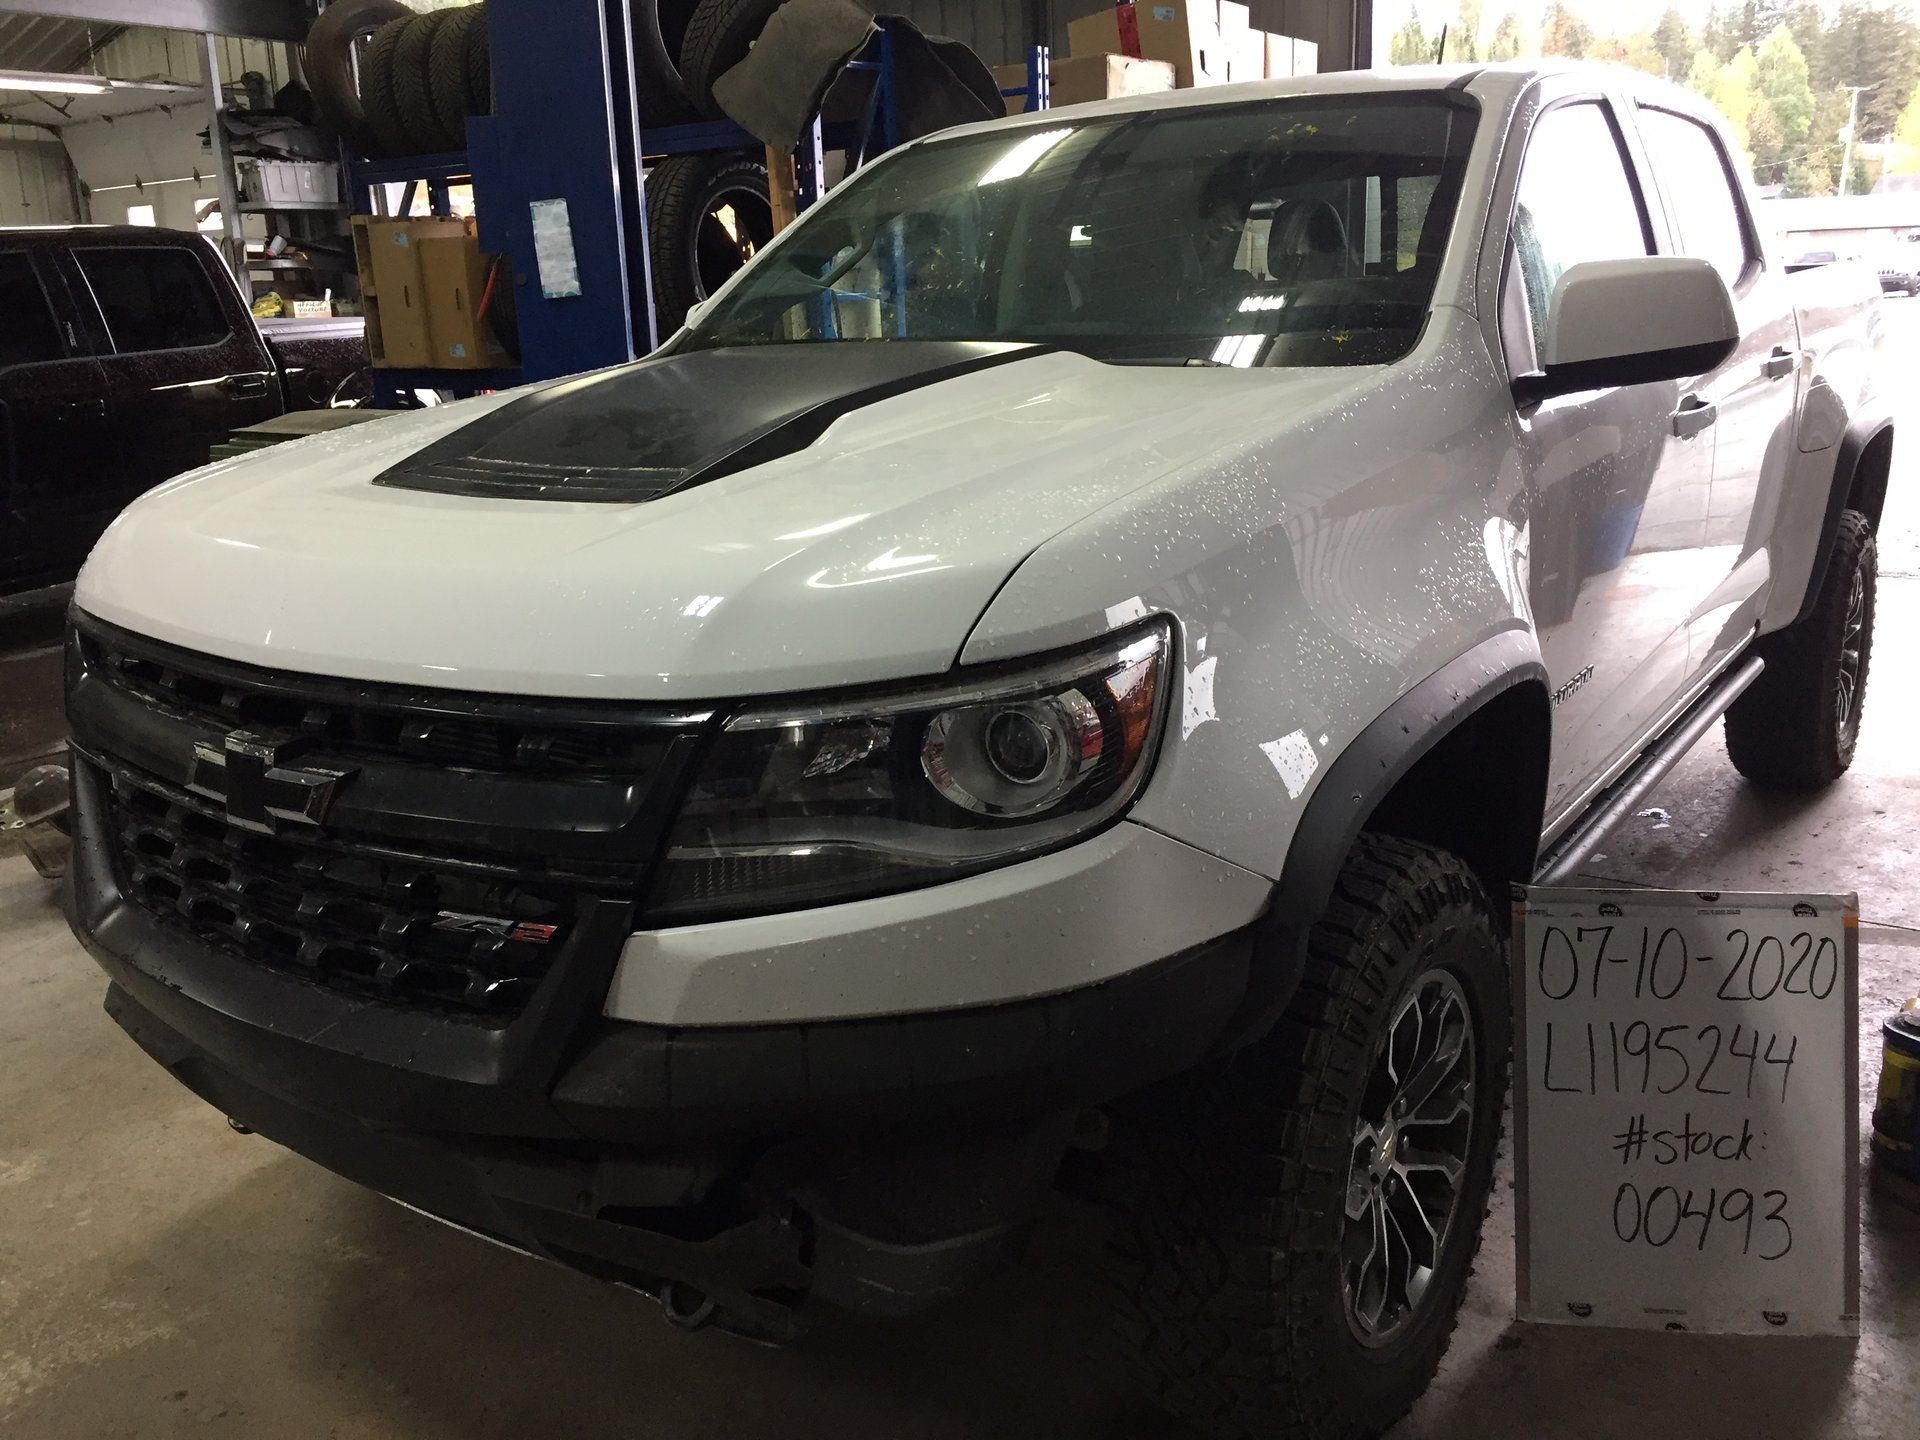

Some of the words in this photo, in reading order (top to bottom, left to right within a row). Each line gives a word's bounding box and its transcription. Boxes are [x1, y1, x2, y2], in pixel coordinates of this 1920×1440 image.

[1539, 926, 1838, 1000] 07-10-2020
[1544, 1021, 1797, 1104] L1195244
[1613, 1183, 1792, 1260] 00493
